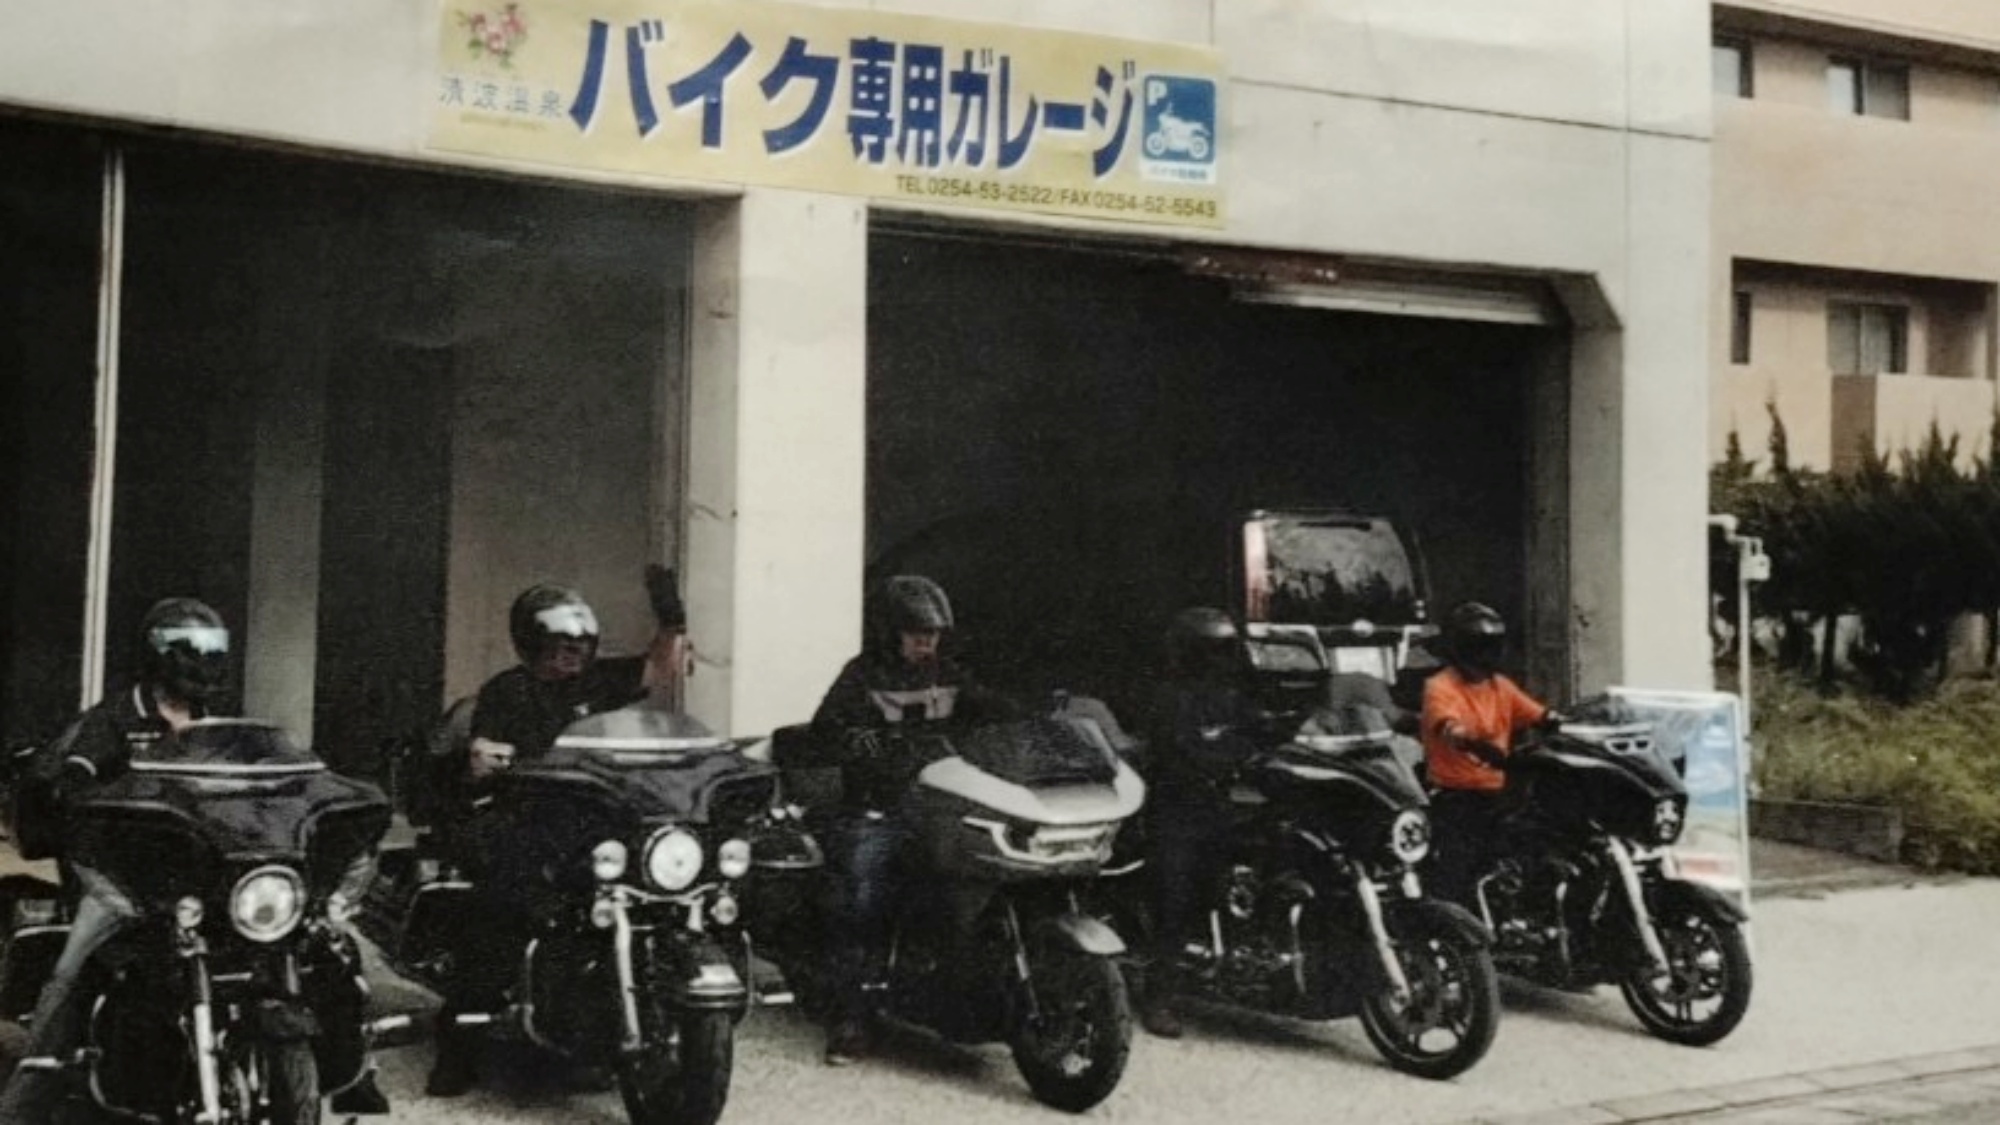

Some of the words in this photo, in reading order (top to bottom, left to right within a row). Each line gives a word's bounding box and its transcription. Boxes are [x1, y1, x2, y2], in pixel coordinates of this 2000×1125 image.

[568, 19, 1136, 178] バイク専用ガレージ
[1148, 76, 1167, 105] P
